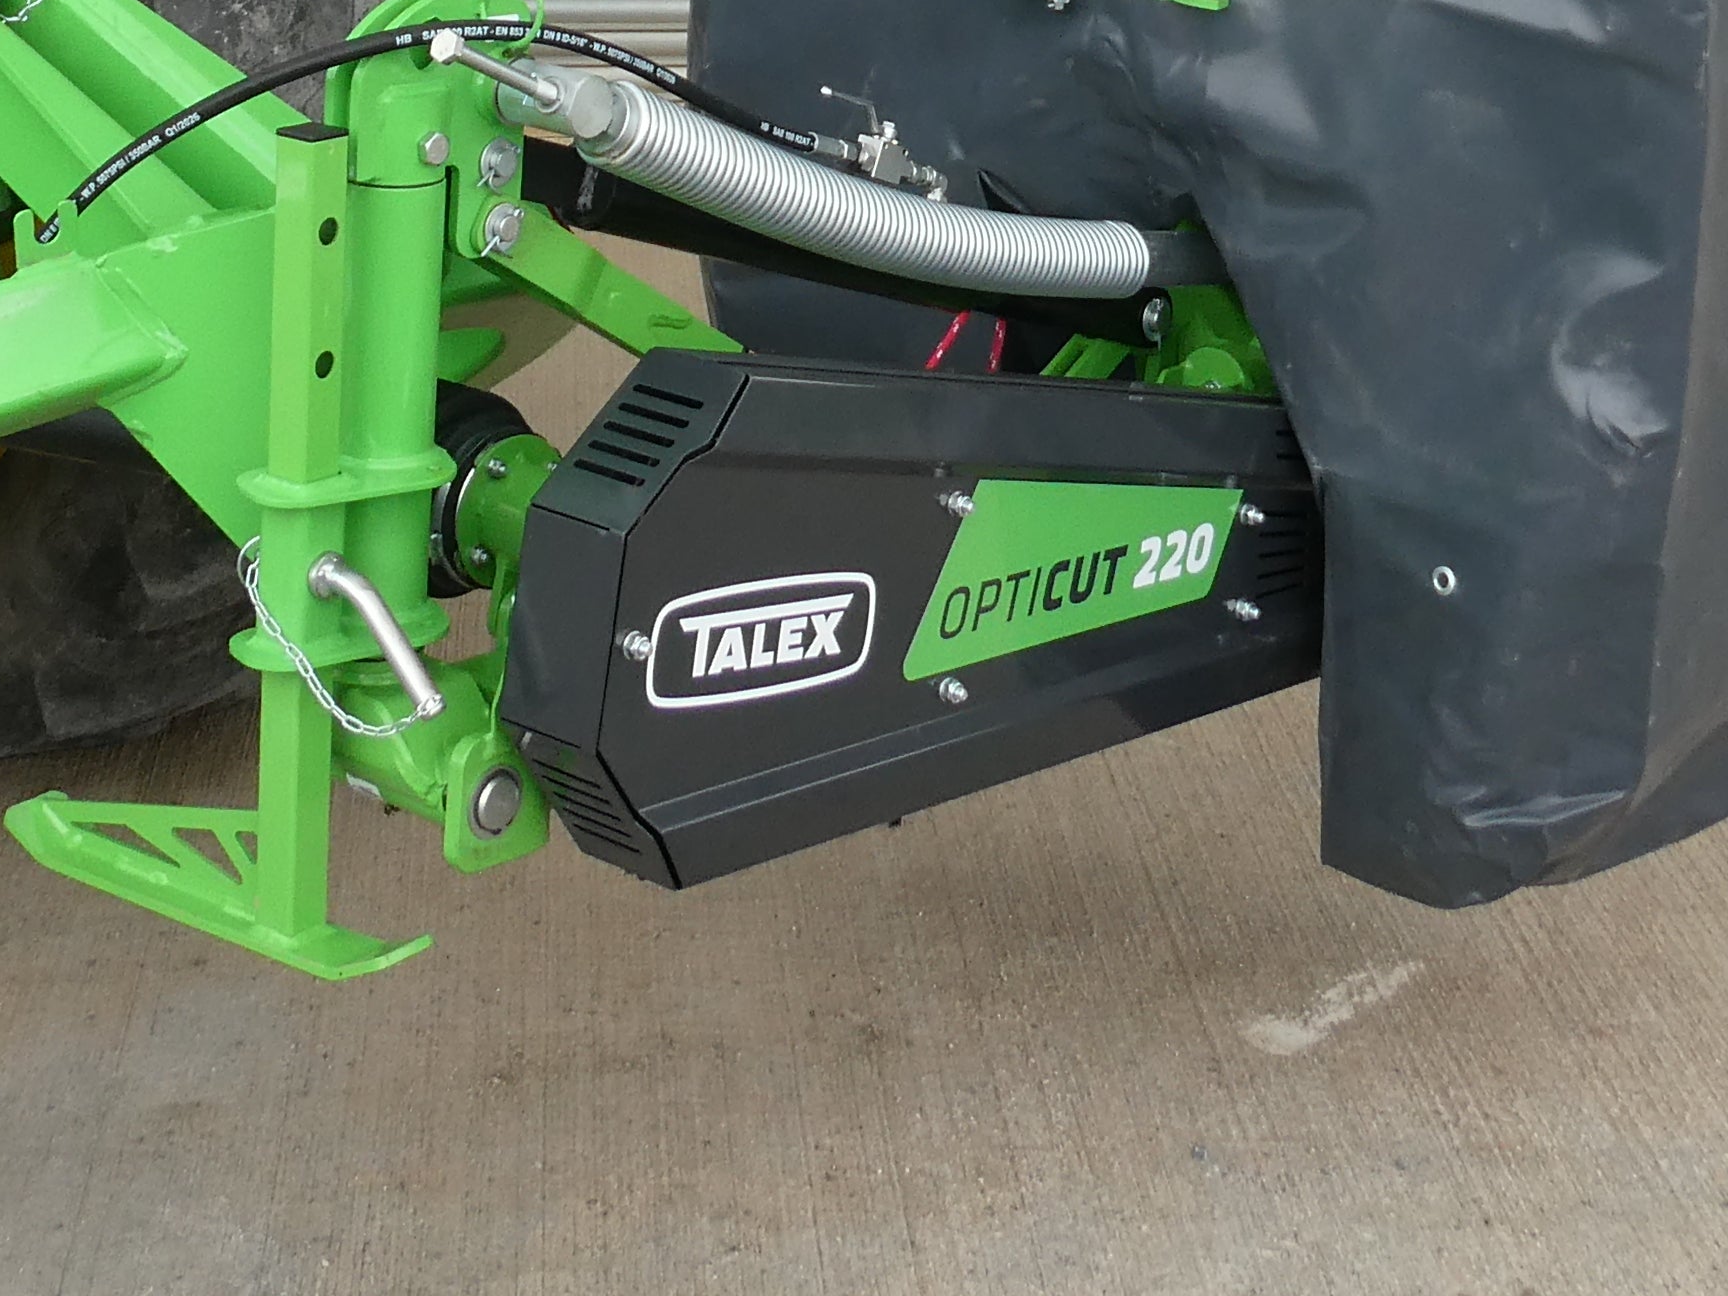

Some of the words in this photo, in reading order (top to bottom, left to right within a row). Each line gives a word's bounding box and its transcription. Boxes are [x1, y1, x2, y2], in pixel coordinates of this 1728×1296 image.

[939, 543, 1130, 640] OPTICUT
[1132, 521, 1215, 590] 220
[679, 592, 855, 679] TALEX
